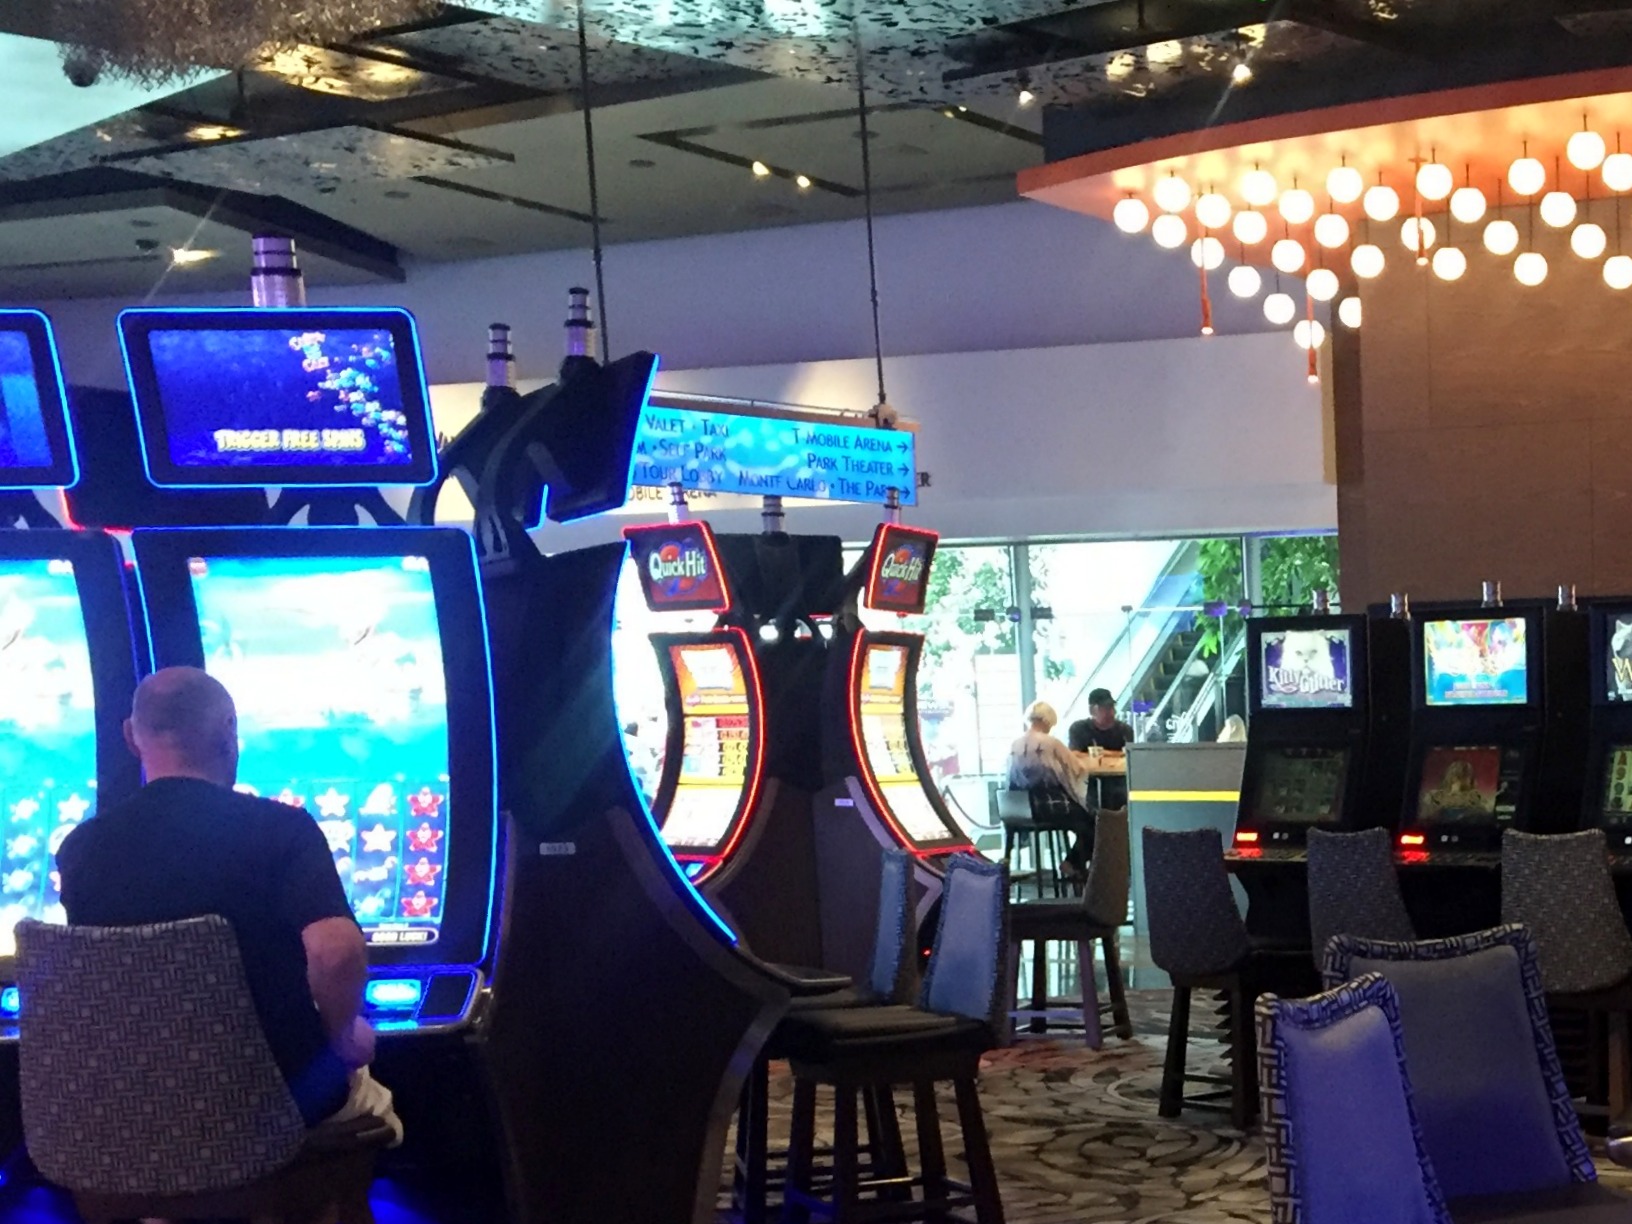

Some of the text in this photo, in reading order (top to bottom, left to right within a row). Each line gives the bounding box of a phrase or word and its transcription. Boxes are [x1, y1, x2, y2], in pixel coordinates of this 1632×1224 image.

[645, 414, 729, 437] VALET TAXI
[282, 429, 321, 451] FREE
[322, 428, 366, 451] SPINS
[854, 434, 893, 452] ARENA
[807, 453, 895, 475] PARK THEATER
[838, 478, 862, 494] THE
[866, 481, 887, 497] PAR
